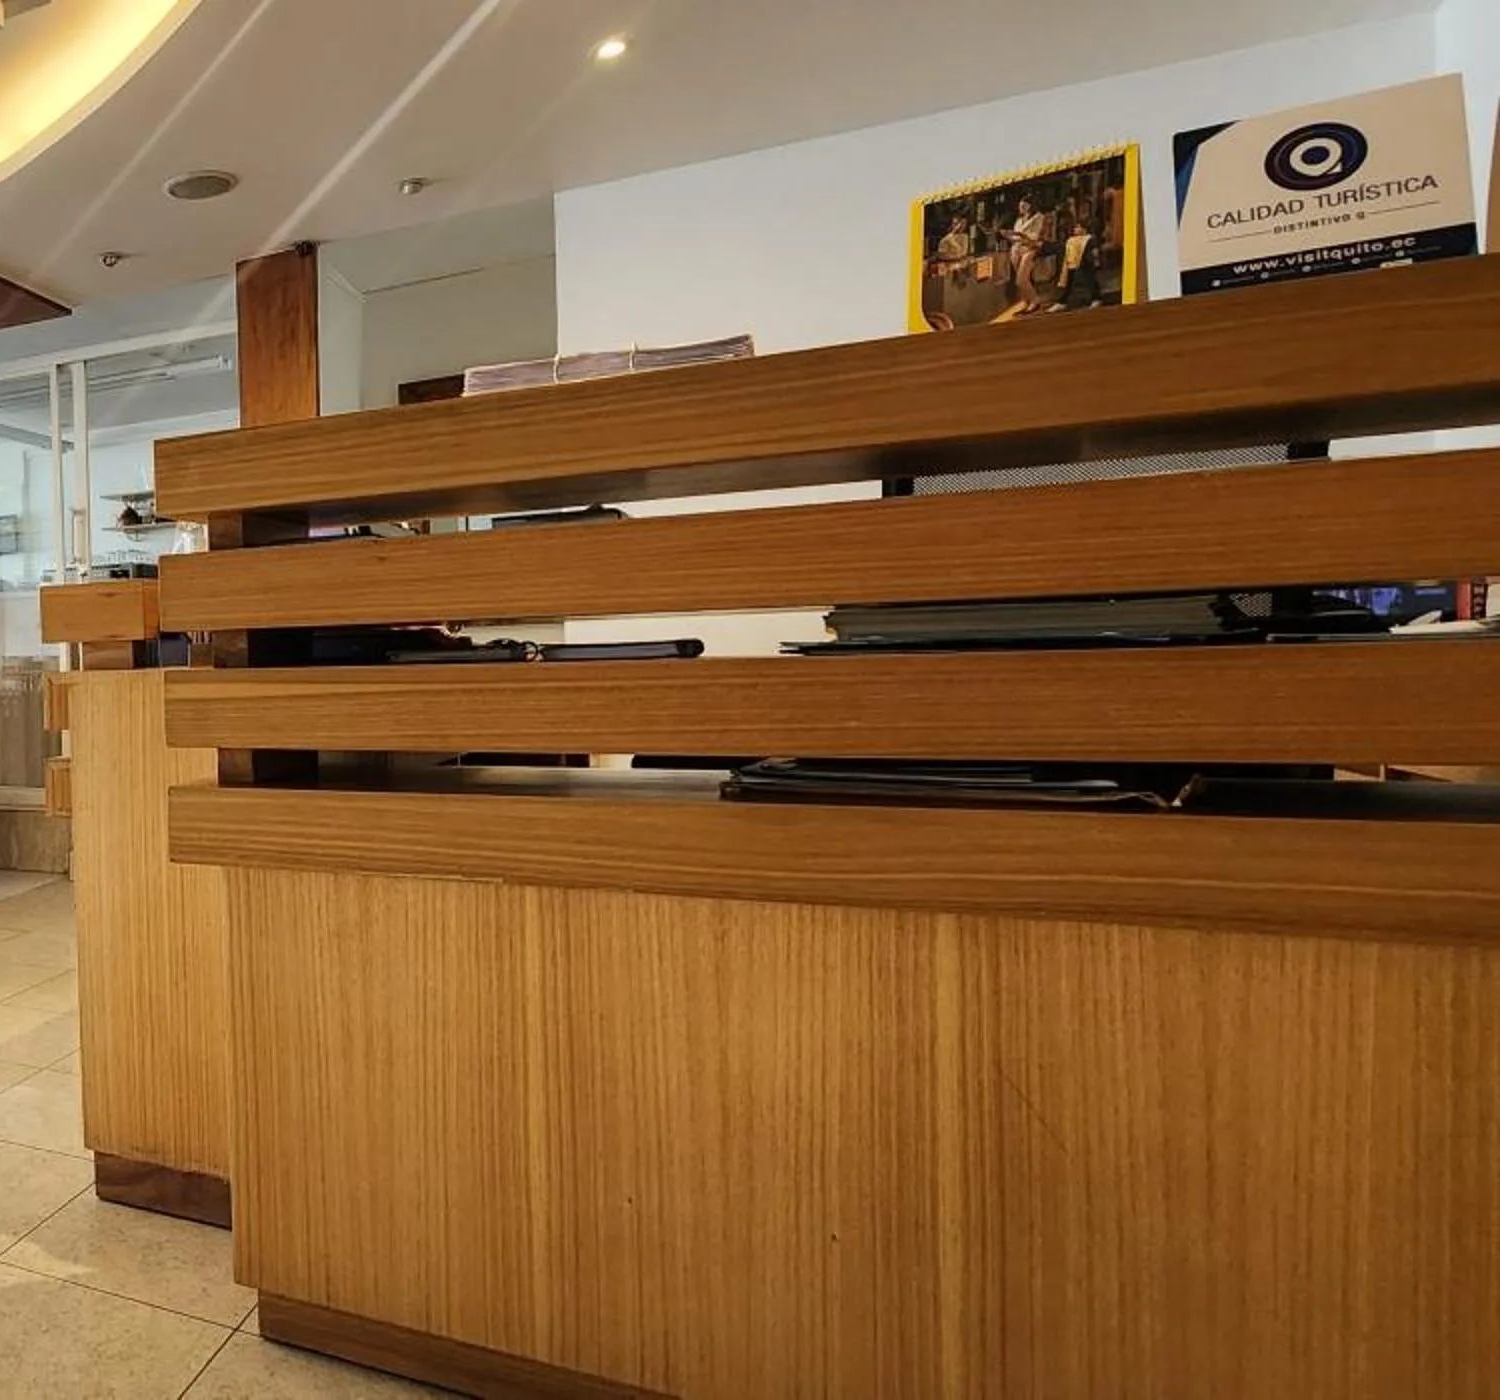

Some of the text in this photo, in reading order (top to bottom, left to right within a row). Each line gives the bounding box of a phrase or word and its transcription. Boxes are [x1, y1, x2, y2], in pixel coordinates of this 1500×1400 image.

[1206, 174, 1439, 230] CALIDAD TURÍSTICA
[1273, 213, 1351, 234] DISTINTIVO
[1232, 236, 1418, 275] www.visitquito.ec
